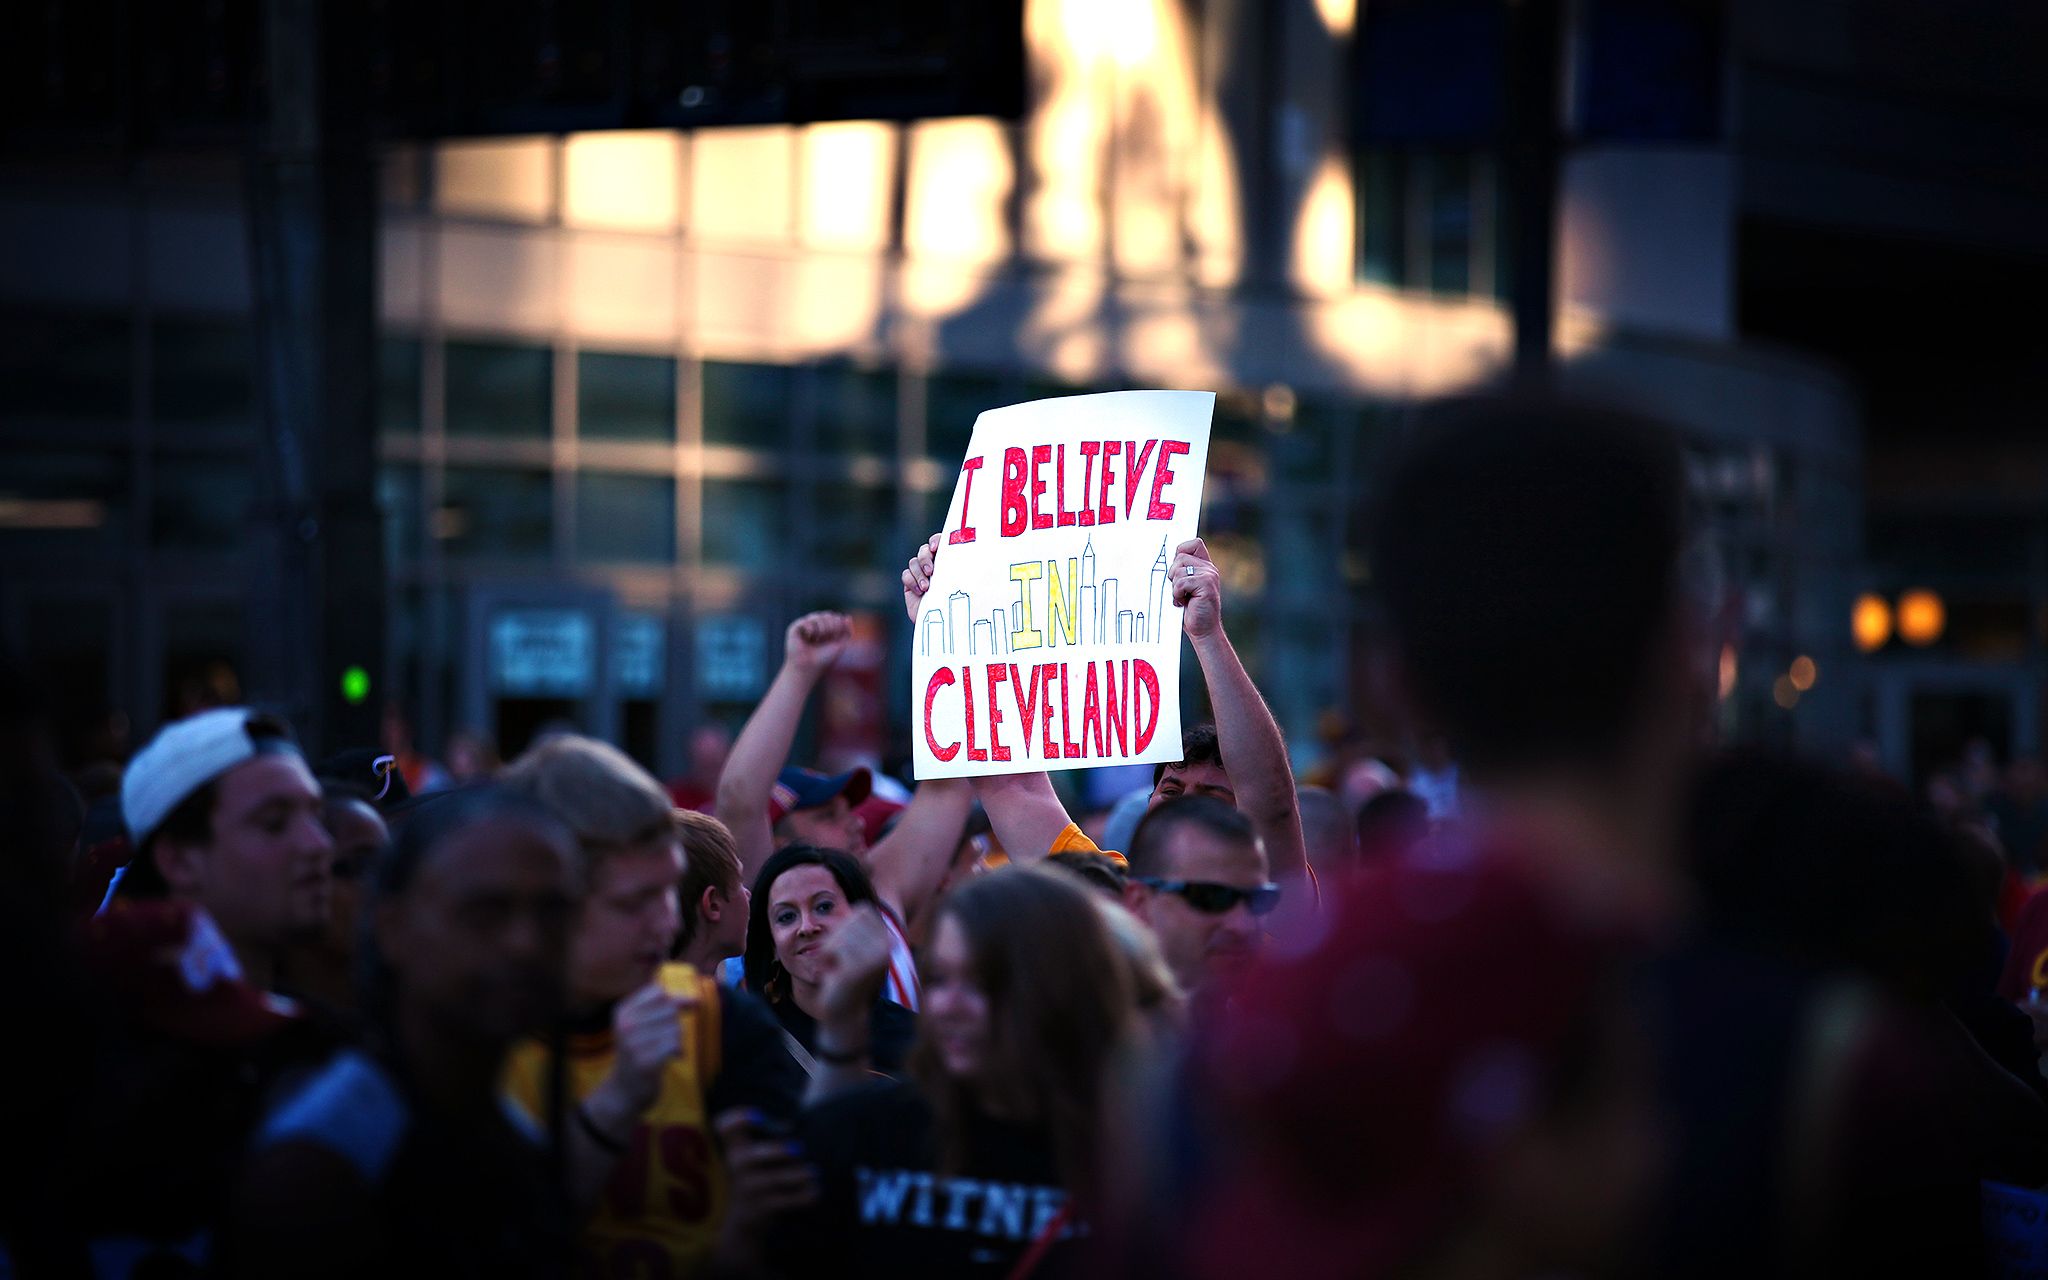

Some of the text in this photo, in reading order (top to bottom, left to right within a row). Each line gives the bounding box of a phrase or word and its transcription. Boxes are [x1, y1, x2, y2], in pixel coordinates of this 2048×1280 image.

[949, 439, 1190, 545] I BELIEVE
[1009, 557, 1078, 652] IN
[923, 658, 1161, 763] CLEVELAND
